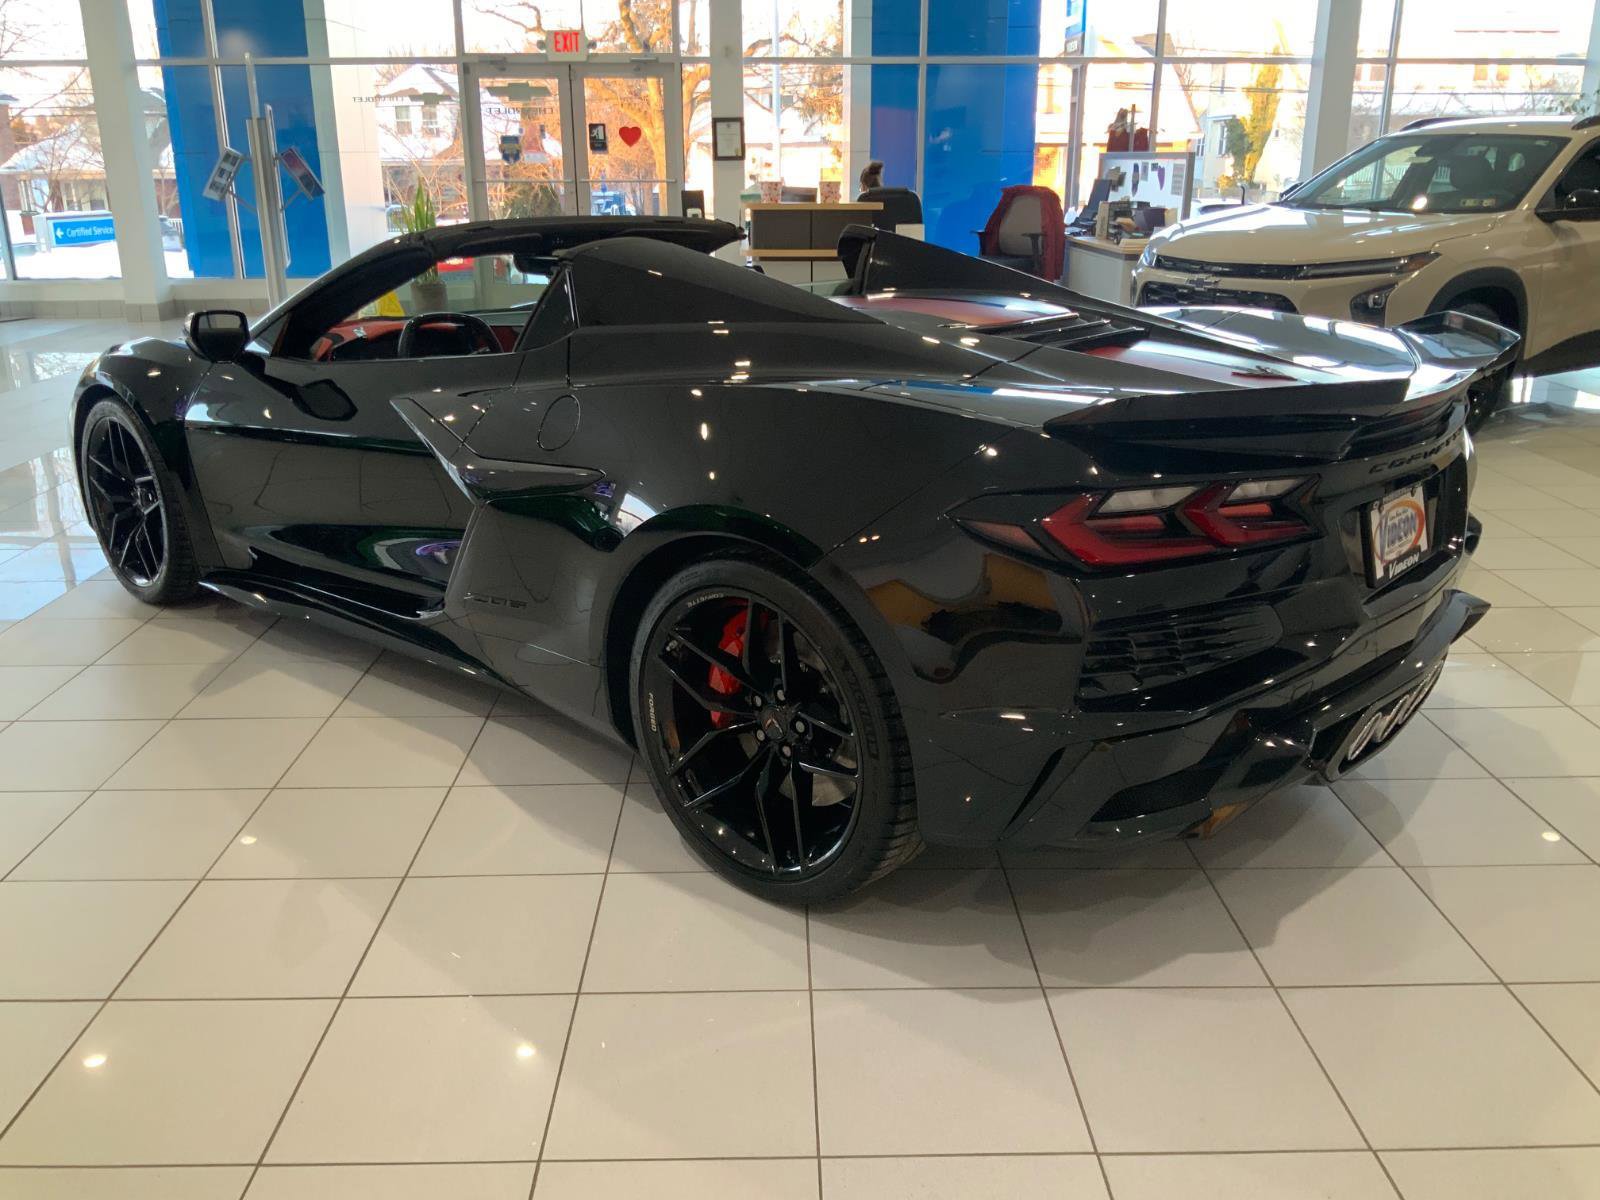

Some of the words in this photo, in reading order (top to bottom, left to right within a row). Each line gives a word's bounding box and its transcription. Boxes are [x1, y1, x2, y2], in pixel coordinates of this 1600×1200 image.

[554, 31, 579, 53] EXIT
[66, 227, 92, 239] Certified
[93, 225, 114, 237] Service
[1389, 551, 1421, 579] VIDEON
